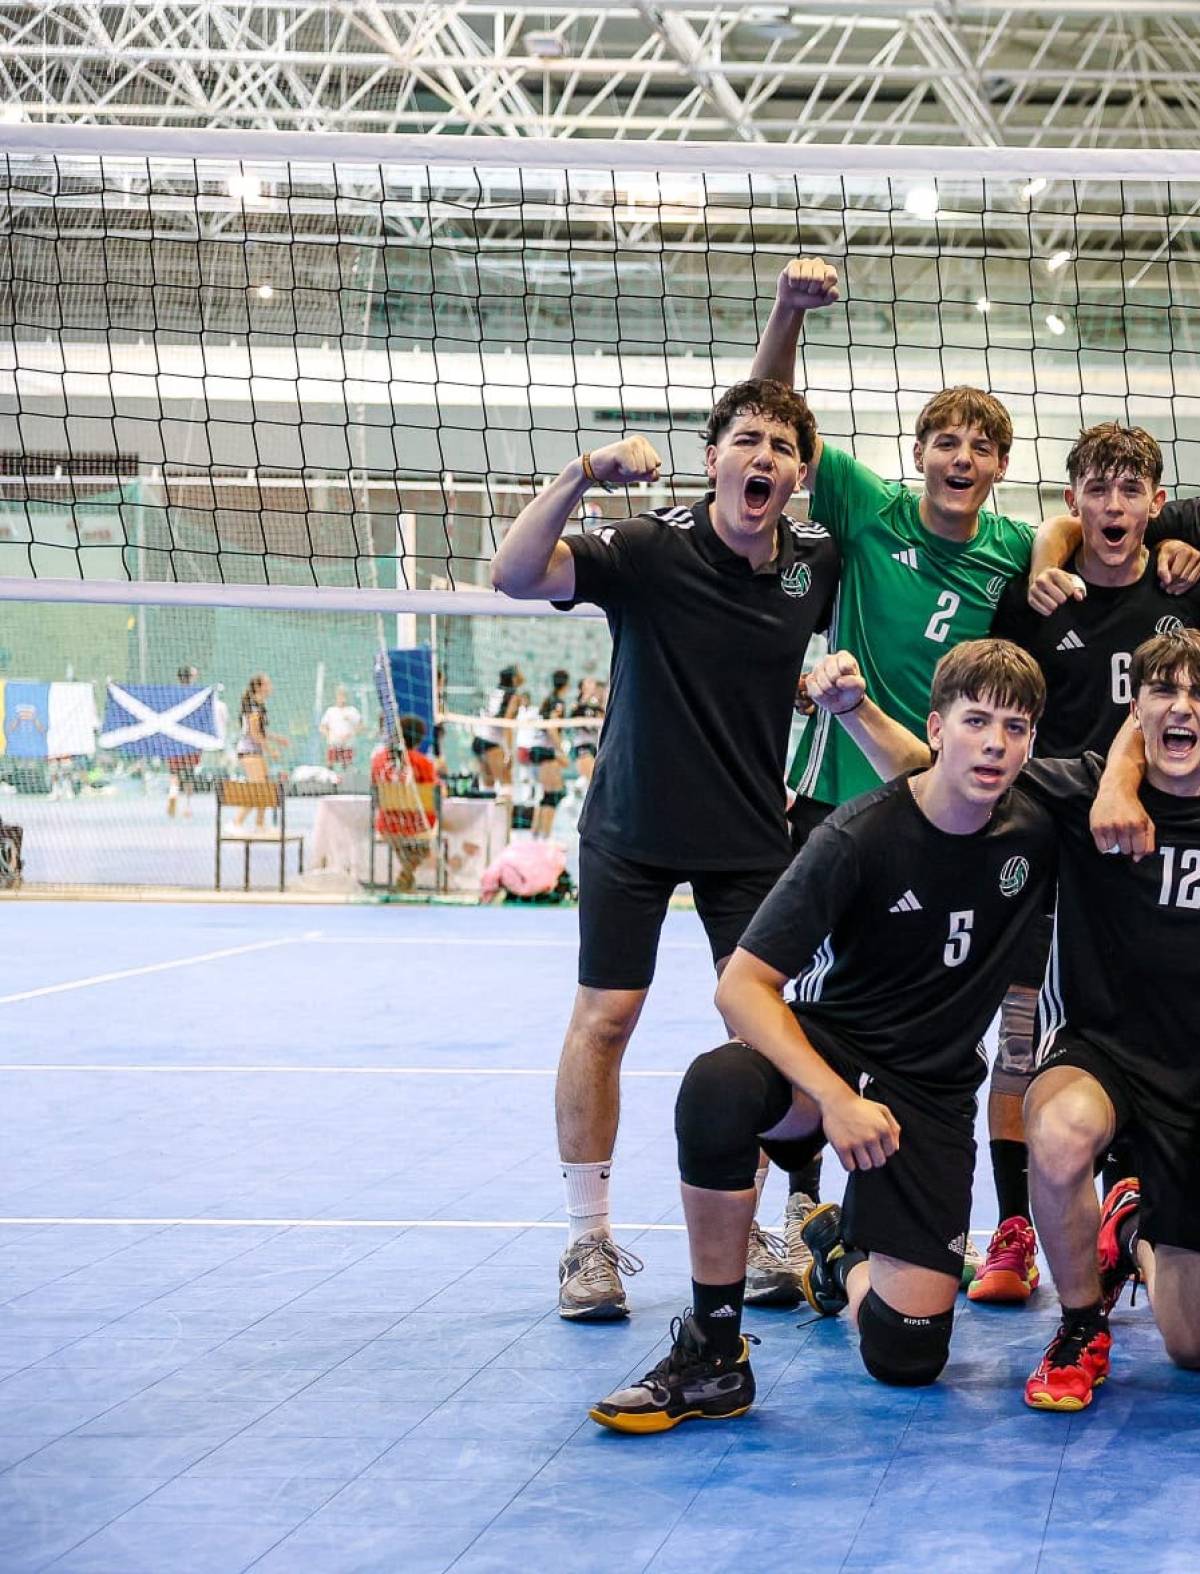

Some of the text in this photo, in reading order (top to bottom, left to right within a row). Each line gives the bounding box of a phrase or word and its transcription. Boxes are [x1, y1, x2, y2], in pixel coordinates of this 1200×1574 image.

[924, 590, 961, 643] 2
[1110, 651, 1133, 704] 6
[943, 910, 974, 967] 5
[903, 1317, 931, 1326] KIPSTA
